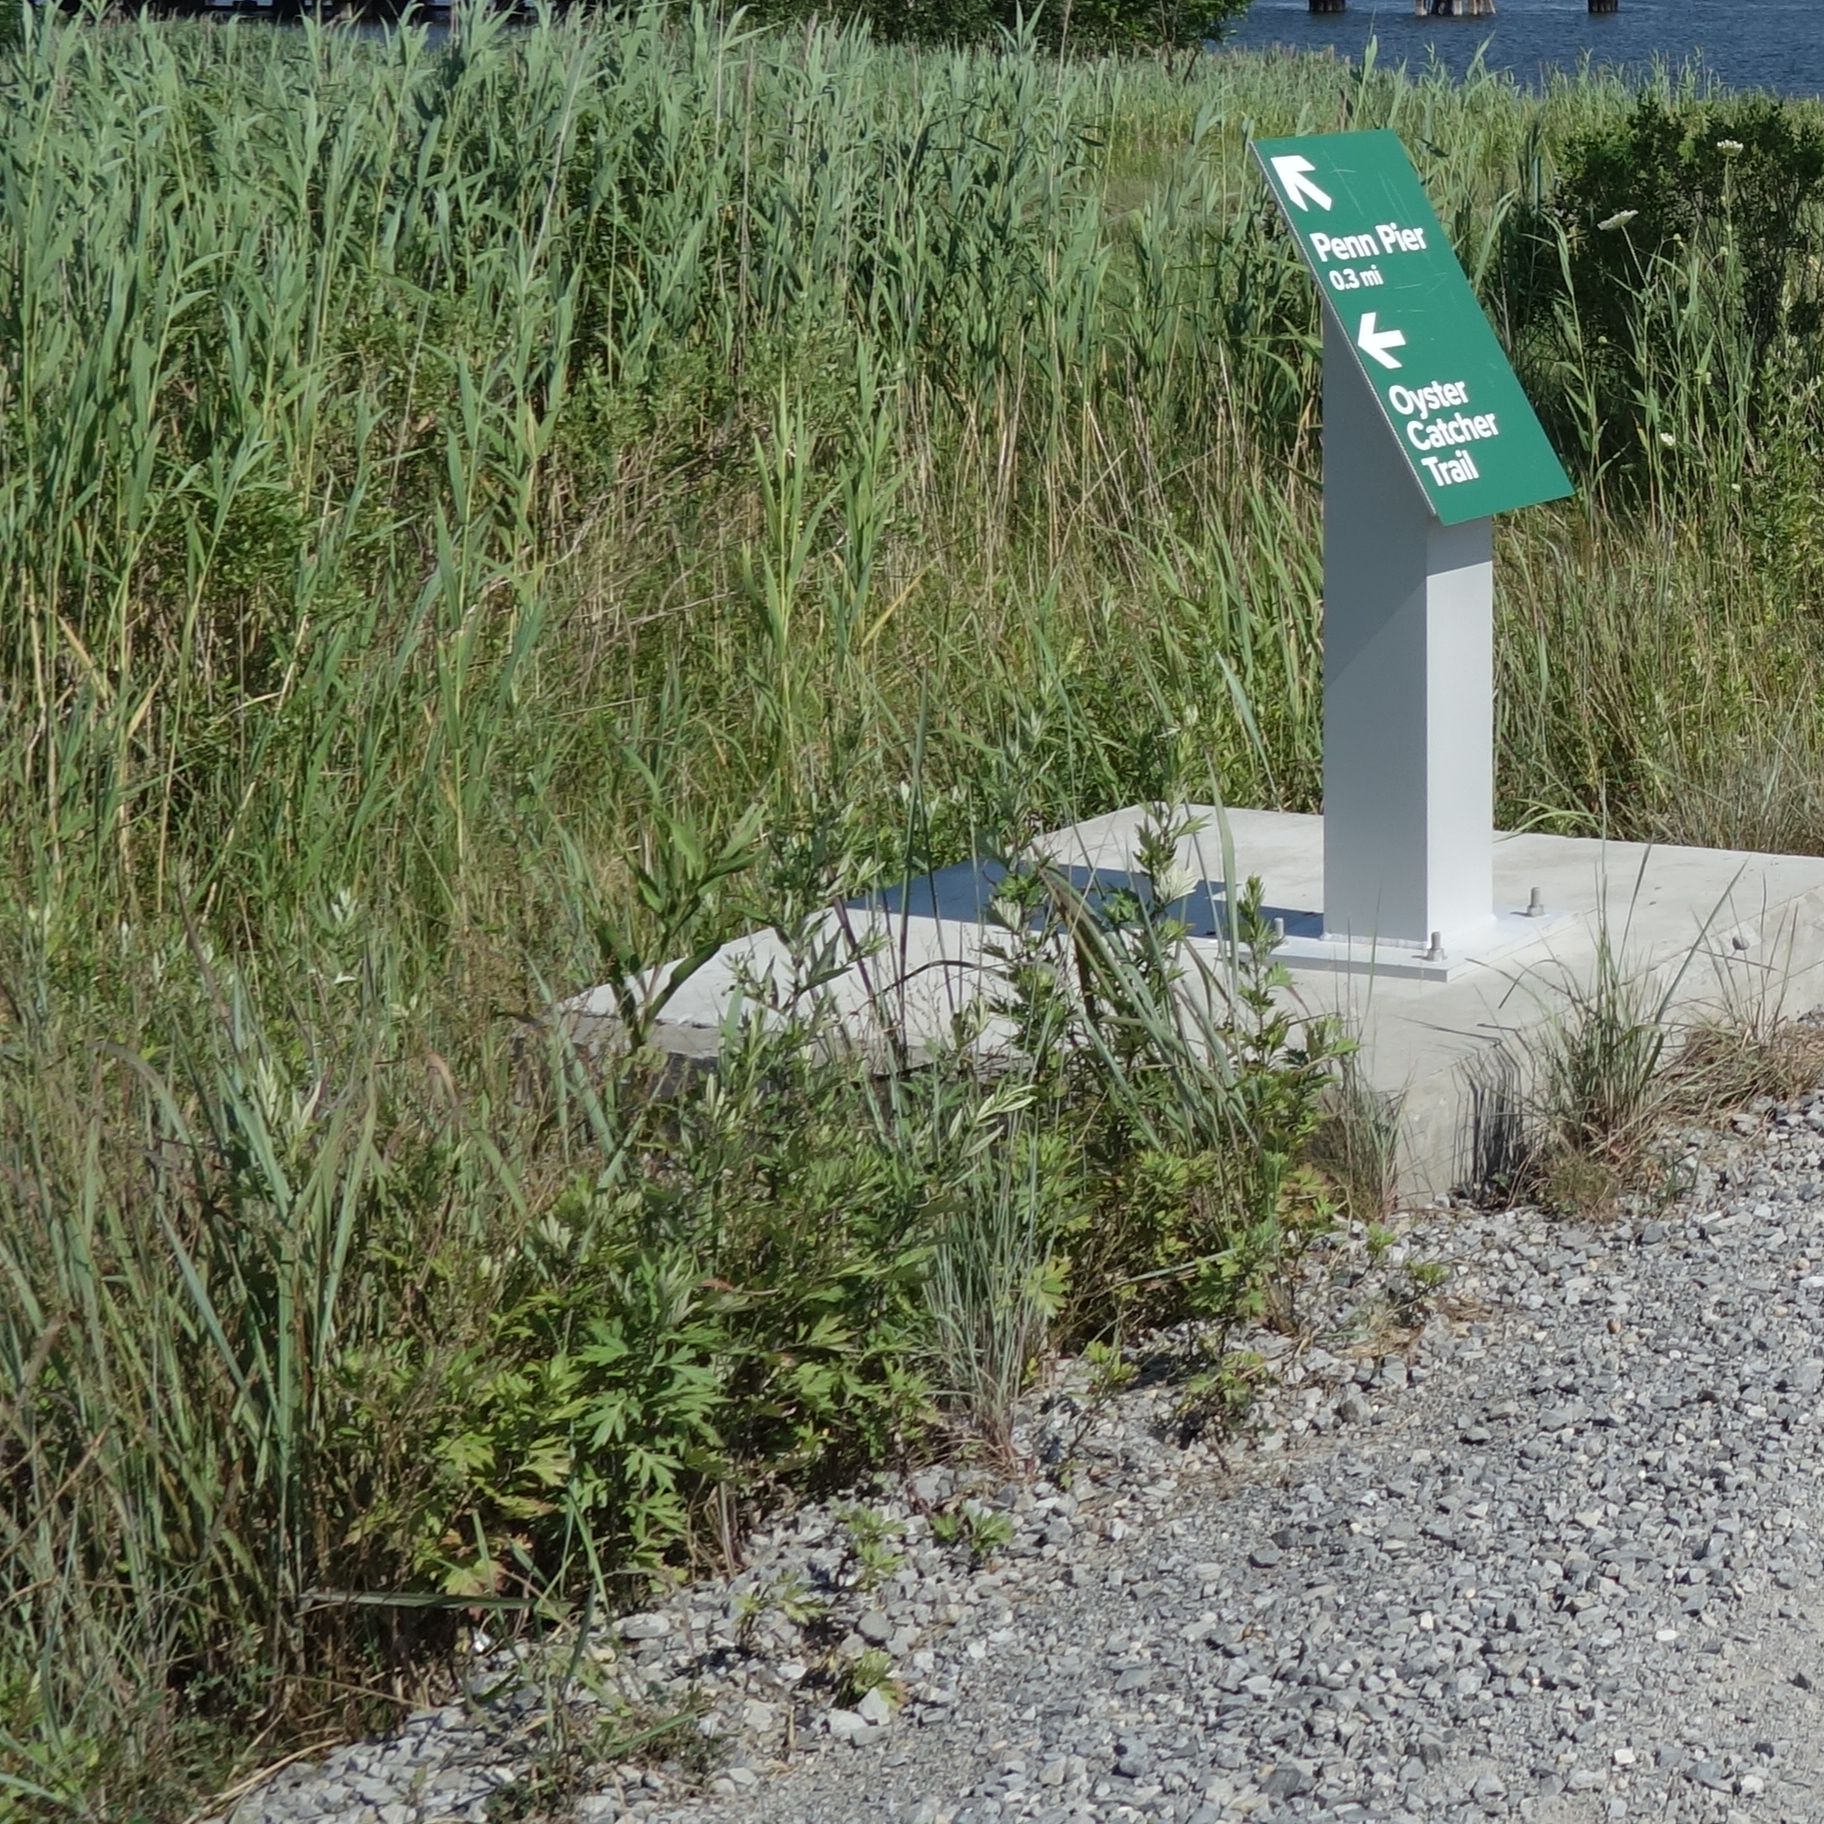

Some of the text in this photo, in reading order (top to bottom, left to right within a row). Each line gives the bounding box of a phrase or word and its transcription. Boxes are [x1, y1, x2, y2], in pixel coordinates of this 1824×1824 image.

[1309, 221, 1427, 263] Penn Pier
[1328, 264, 1384, 291] 0.3 mi
[1388, 380, 1469, 420] Oyster
[1406, 412, 1499, 451] Catcher
[1420, 449, 1480, 487] Trail
